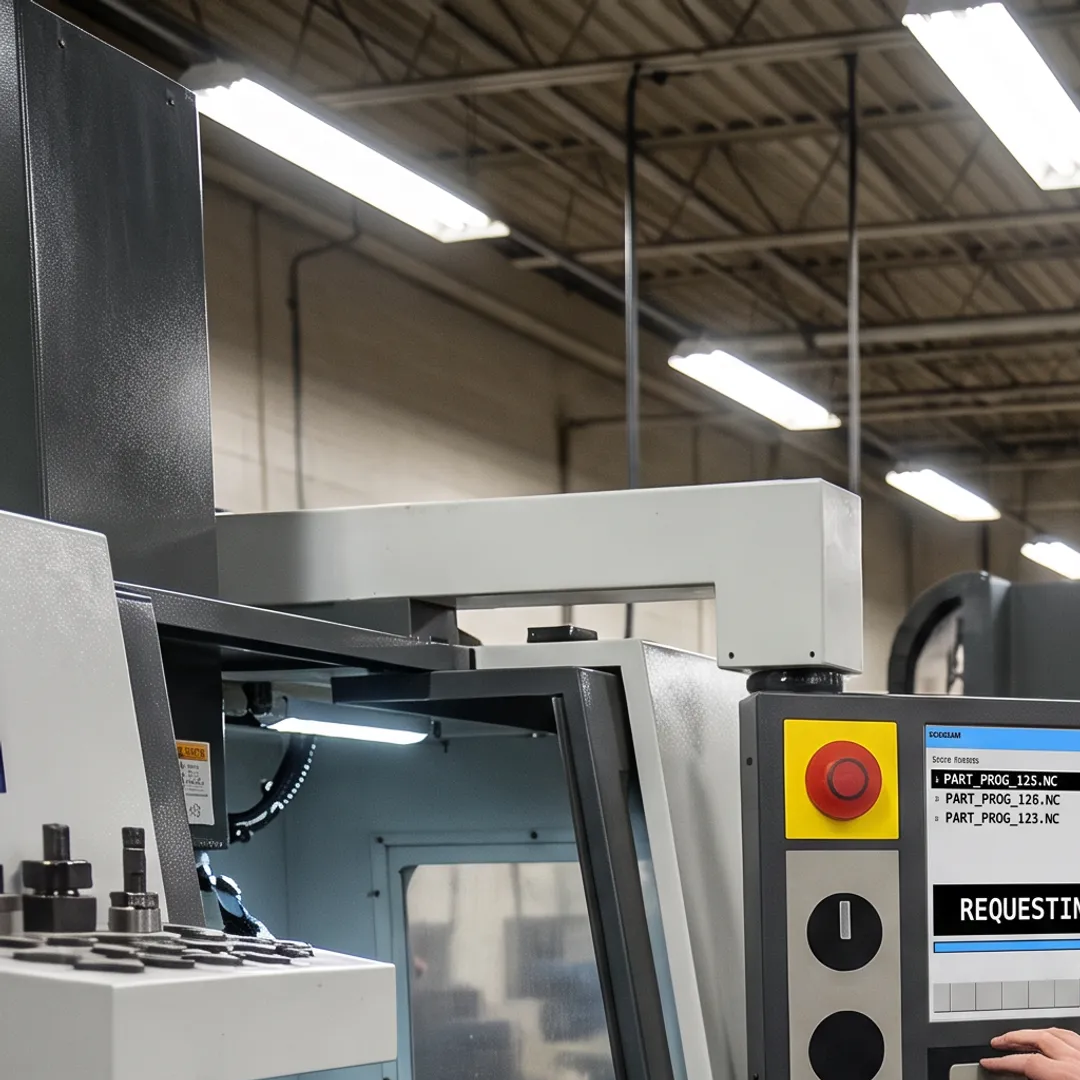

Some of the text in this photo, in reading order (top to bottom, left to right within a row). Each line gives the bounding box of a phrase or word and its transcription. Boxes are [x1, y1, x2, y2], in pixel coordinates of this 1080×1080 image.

[943, 773, 1058, 788] PART_PROG_125.NC
[945, 792, 1060, 808] PART_PROG_126.NC
[945, 811, 1060, 826] PART_PROG_123.NC
